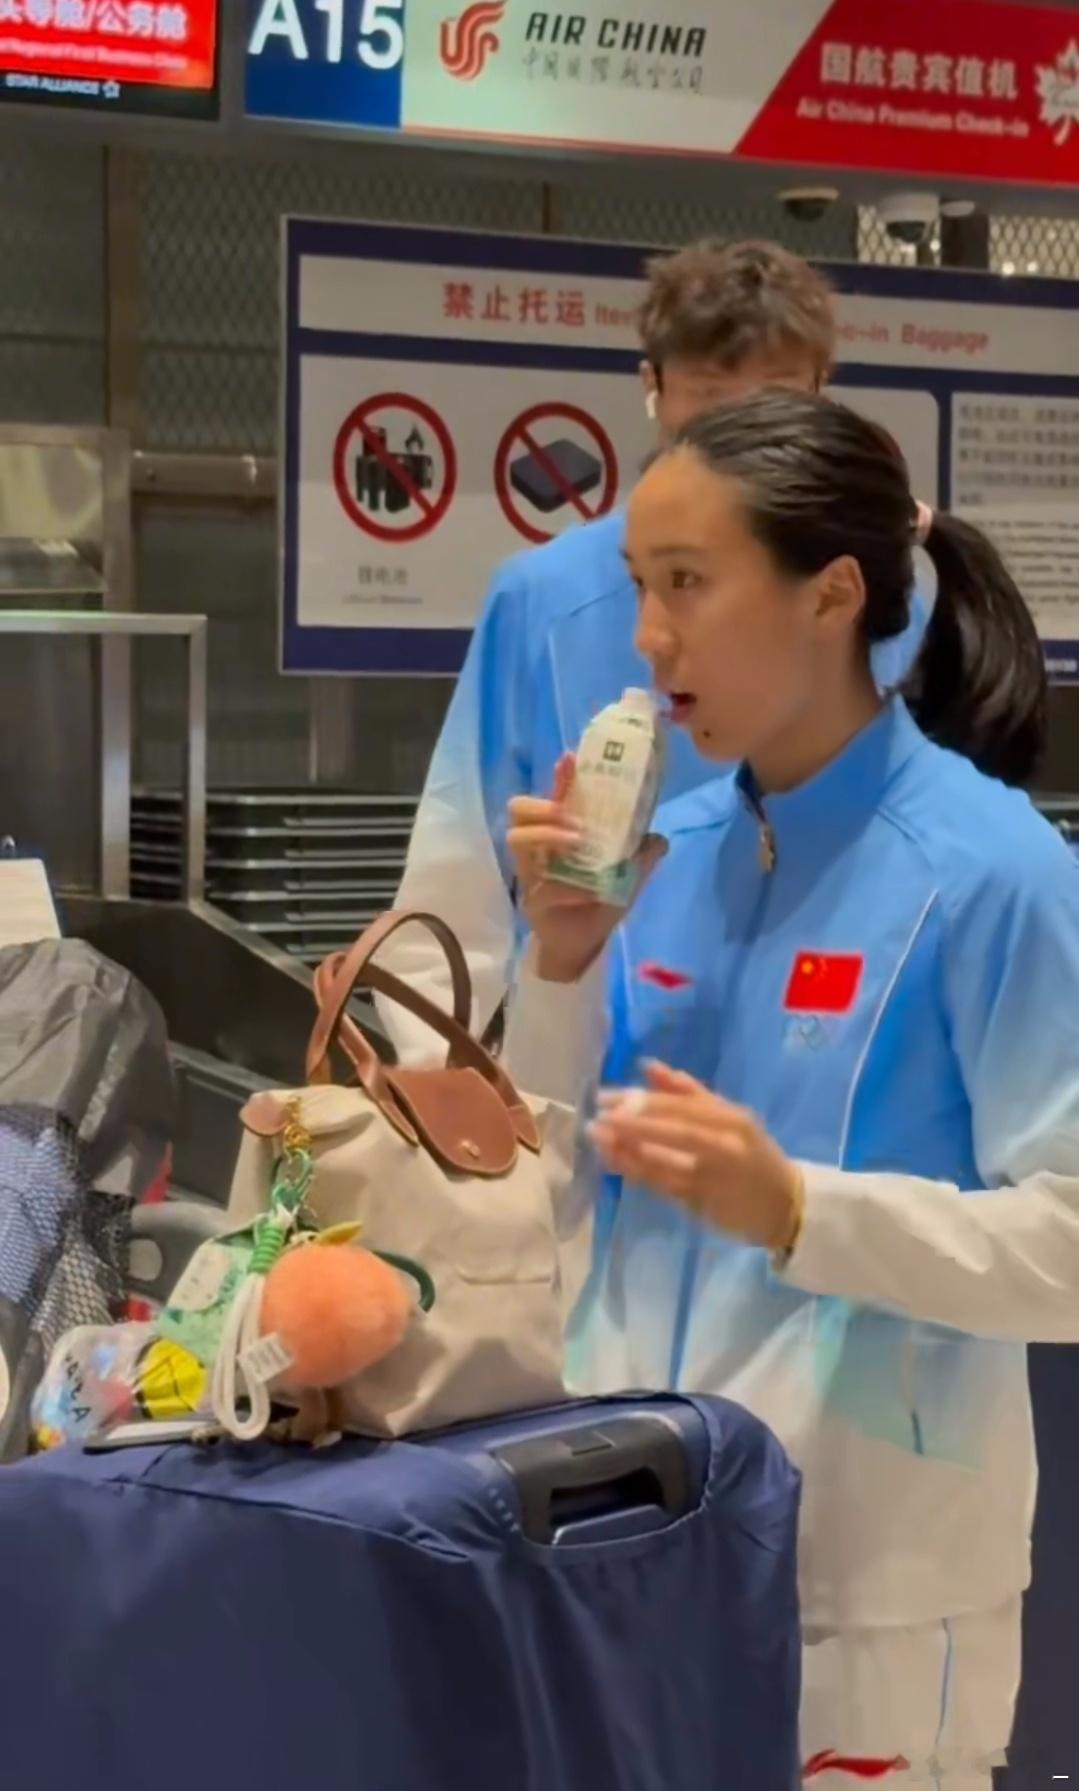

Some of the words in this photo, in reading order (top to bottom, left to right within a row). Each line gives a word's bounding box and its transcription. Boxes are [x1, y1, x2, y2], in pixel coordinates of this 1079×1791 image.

[248, 0, 403, 69] A15
[525, 12, 587, 45] AIR
[597, 19, 707, 57] CHINA
[821, 42, 1018, 100] 国航贵宾值机
[797, 97, 823, 119] Air
[827, 101, 875, 124] China
[878, 105, 952, 130] Premium
[955, 113, 1030, 138] Check-in
[443, 282, 585, 327] 禁止托运
[902, 323, 989, 355] Baggage
